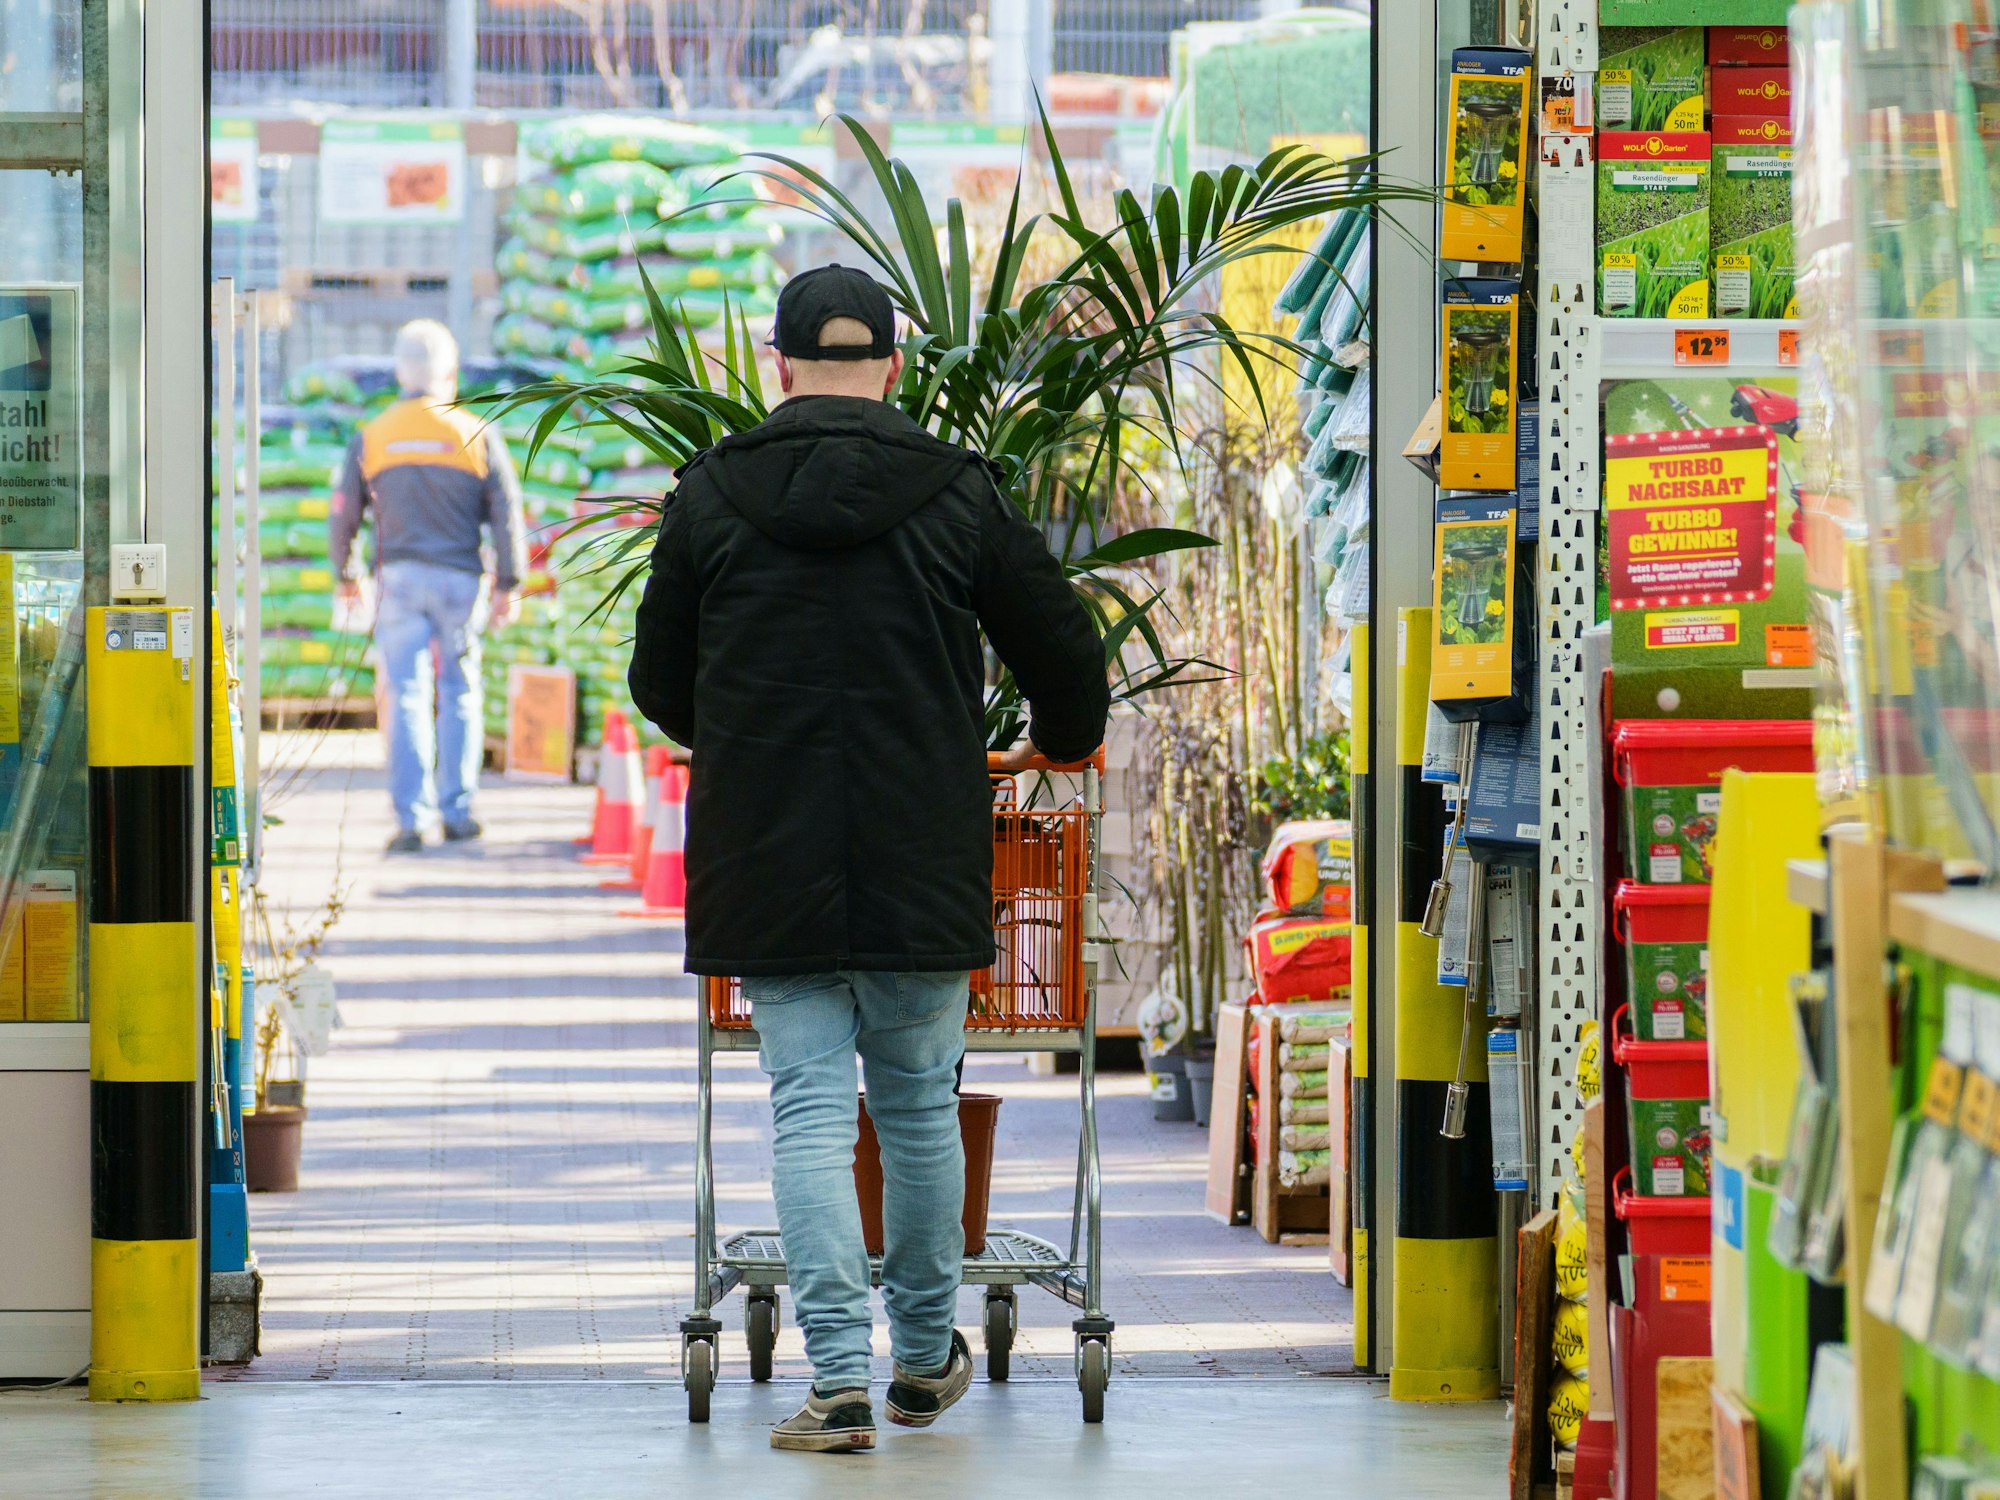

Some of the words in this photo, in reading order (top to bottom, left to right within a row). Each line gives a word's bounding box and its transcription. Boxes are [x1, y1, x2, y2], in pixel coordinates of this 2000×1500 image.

[1502, 66, 1525, 75] TFA
[1605, 71, 1616, 80] 50
[1617, 70, 1627, 79] %
[1554, 76, 1573, 91] 70
[1674, 120, 1686, 129] 50
[1623, 144, 1645, 152] WOLF
[1632, 174, 1678, 183] Rasendünger
[1610, 255, 1620, 264] 50
[1621, 255, 1631, 264] %
[1722, 256, 1734, 265] 50
[1735, 256, 1745, 265] %
[1490, 295, 1512, 304] TFA
[1678, 304, 1690, 313] 50
[1690, 338, 1713, 356] 12
[1714, 336, 1727, 346] 99
[0, 399, 46, 427] tahl
[0, 434, 60, 462] icht!
[1649, 457, 1723, 479] TURBO
[0, 476, 70, 488] eoüberwacht.
[1628, 477, 1745, 501] NACHSAAT
[8, 496, 56, 507] Diebstahl
[1487, 510, 1510, 519] TFA
[1645, 508, 1722, 531] TURBO
[0, 514, 16, 526] ge.
[1628, 528, 1738, 554] GEWINNE!
[1627, 564, 1651, 574] Jetzt
[1652, 563, 1681, 572] Rasen
[1682, 559, 1732, 571] reparieren
[1631, 574, 1656, 583] satte
[1704, 799, 1720, 807] Turb
